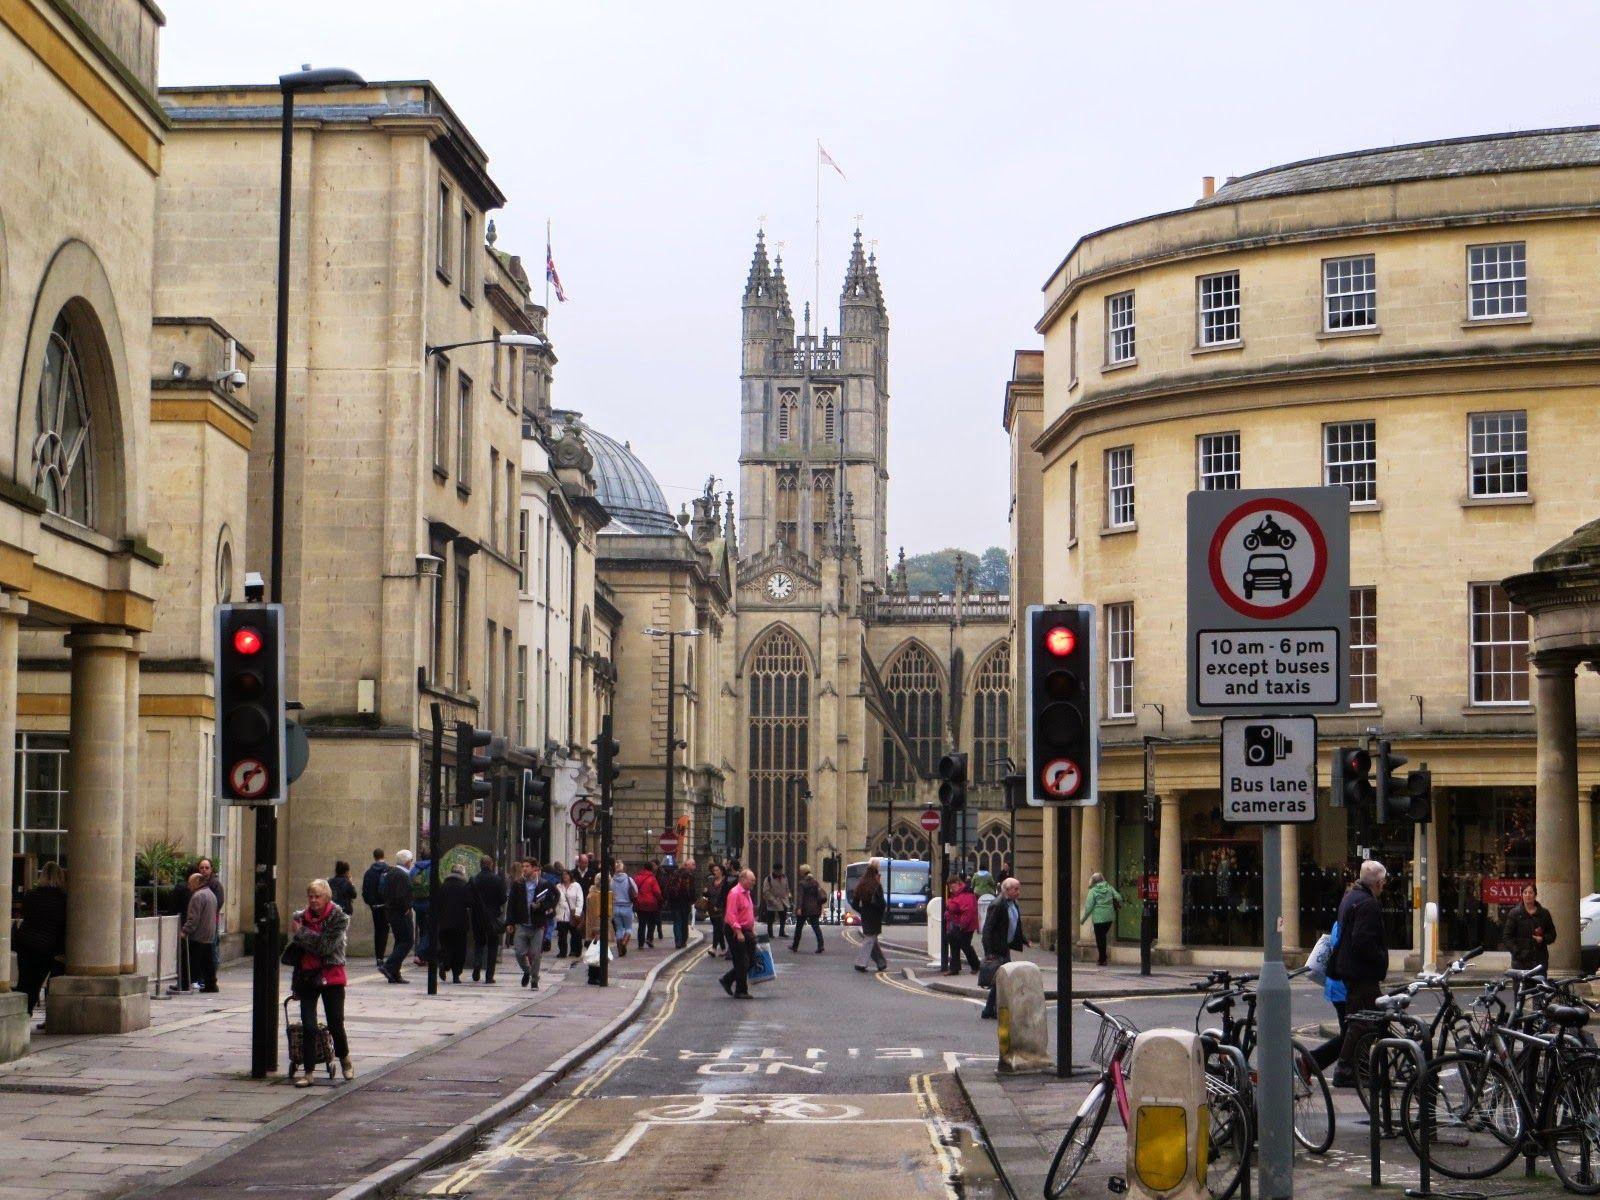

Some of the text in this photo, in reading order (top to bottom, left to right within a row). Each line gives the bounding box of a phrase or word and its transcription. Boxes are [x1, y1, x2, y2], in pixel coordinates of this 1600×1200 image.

[1211, 638, 1232, 655] 10
[1236, 641, 1264, 654] am
[1280, 638, 1292, 654] 6
[1296, 640, 1325, 657] pm
[1206, 658, 1330, 677] except buses
[1225, 679, 1311, 695] and taxis
[1230, 777, 1308, 792] Bus lane
[1231, 799, 1307, 813] cameras
